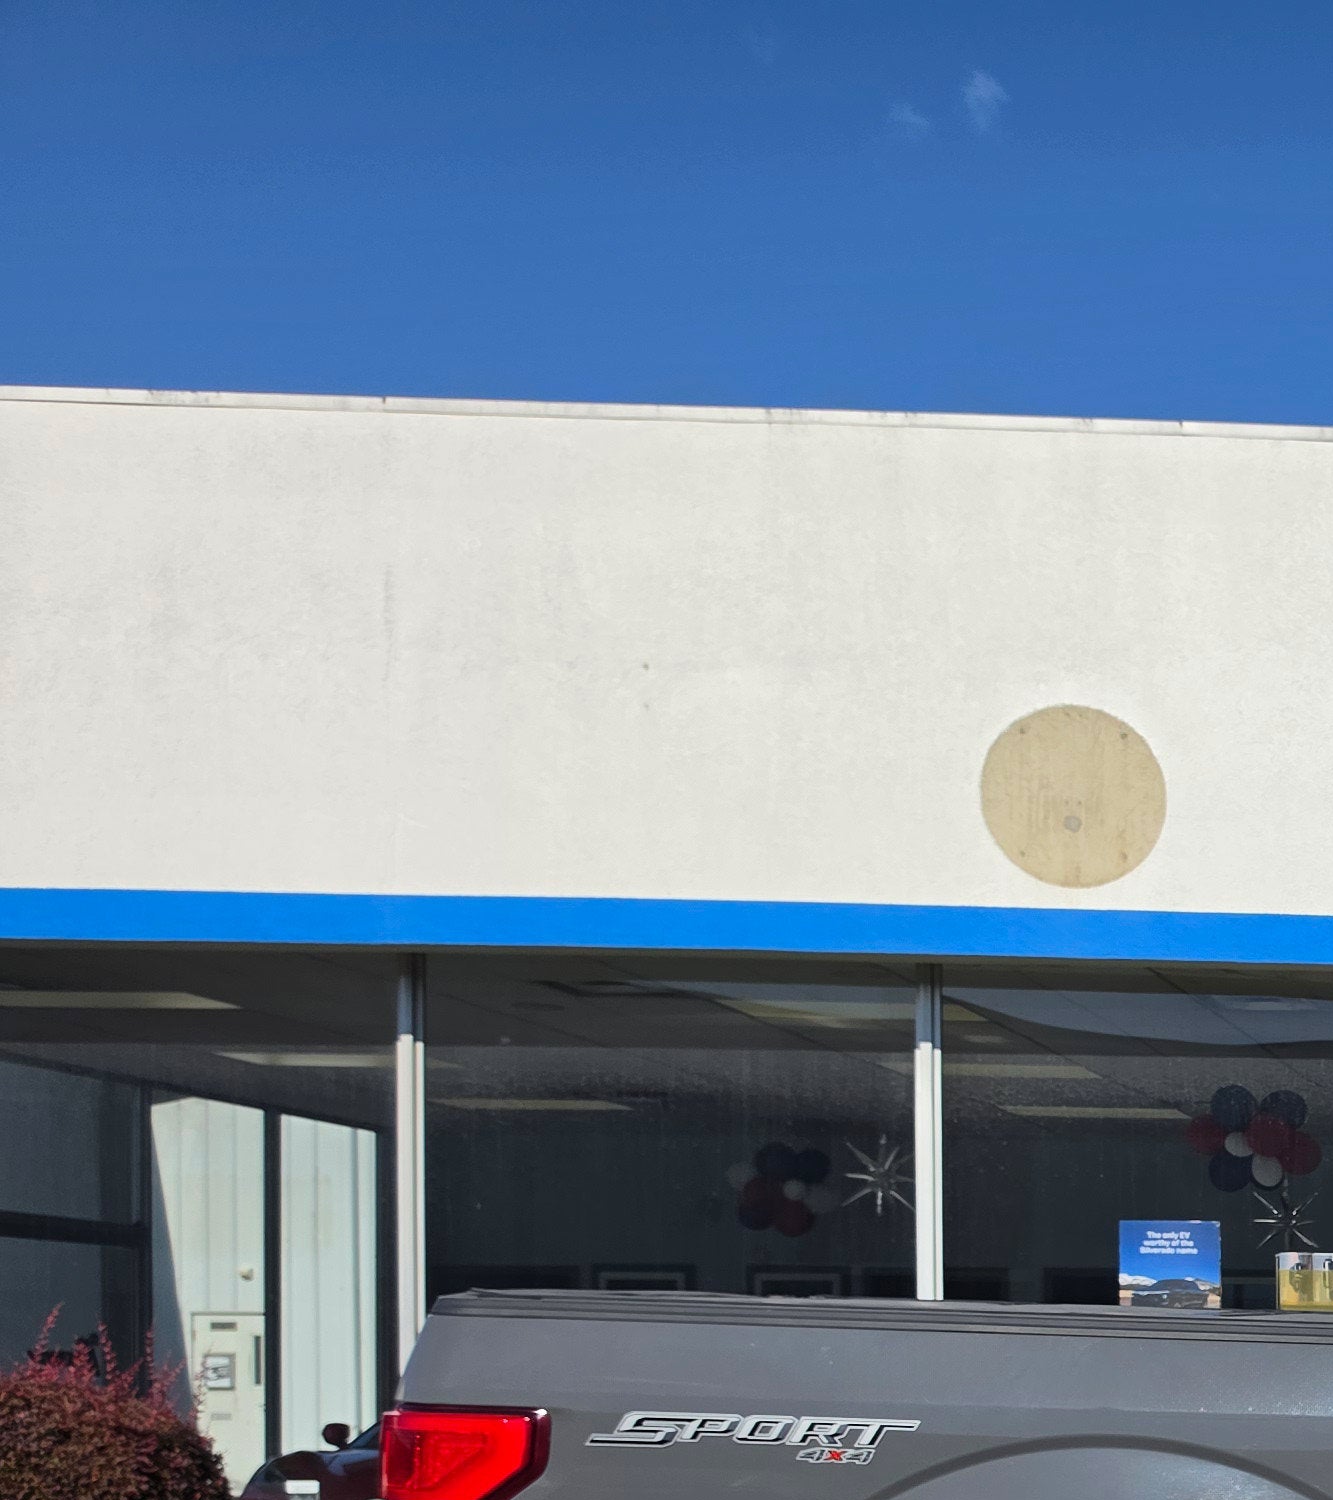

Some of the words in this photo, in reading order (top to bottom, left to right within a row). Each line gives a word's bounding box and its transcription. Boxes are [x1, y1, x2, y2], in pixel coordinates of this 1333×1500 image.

[1146, 1230, 1162, 1239] The
[1162, 1231, 1179, 1240] only
[1179, 1231, 1191, 1239] EV
[1143, 1239, 1171, 1248] worthy
[1171, 1239, 1180, 1247] of
[584, 1410, 922, 1448] SPORT
